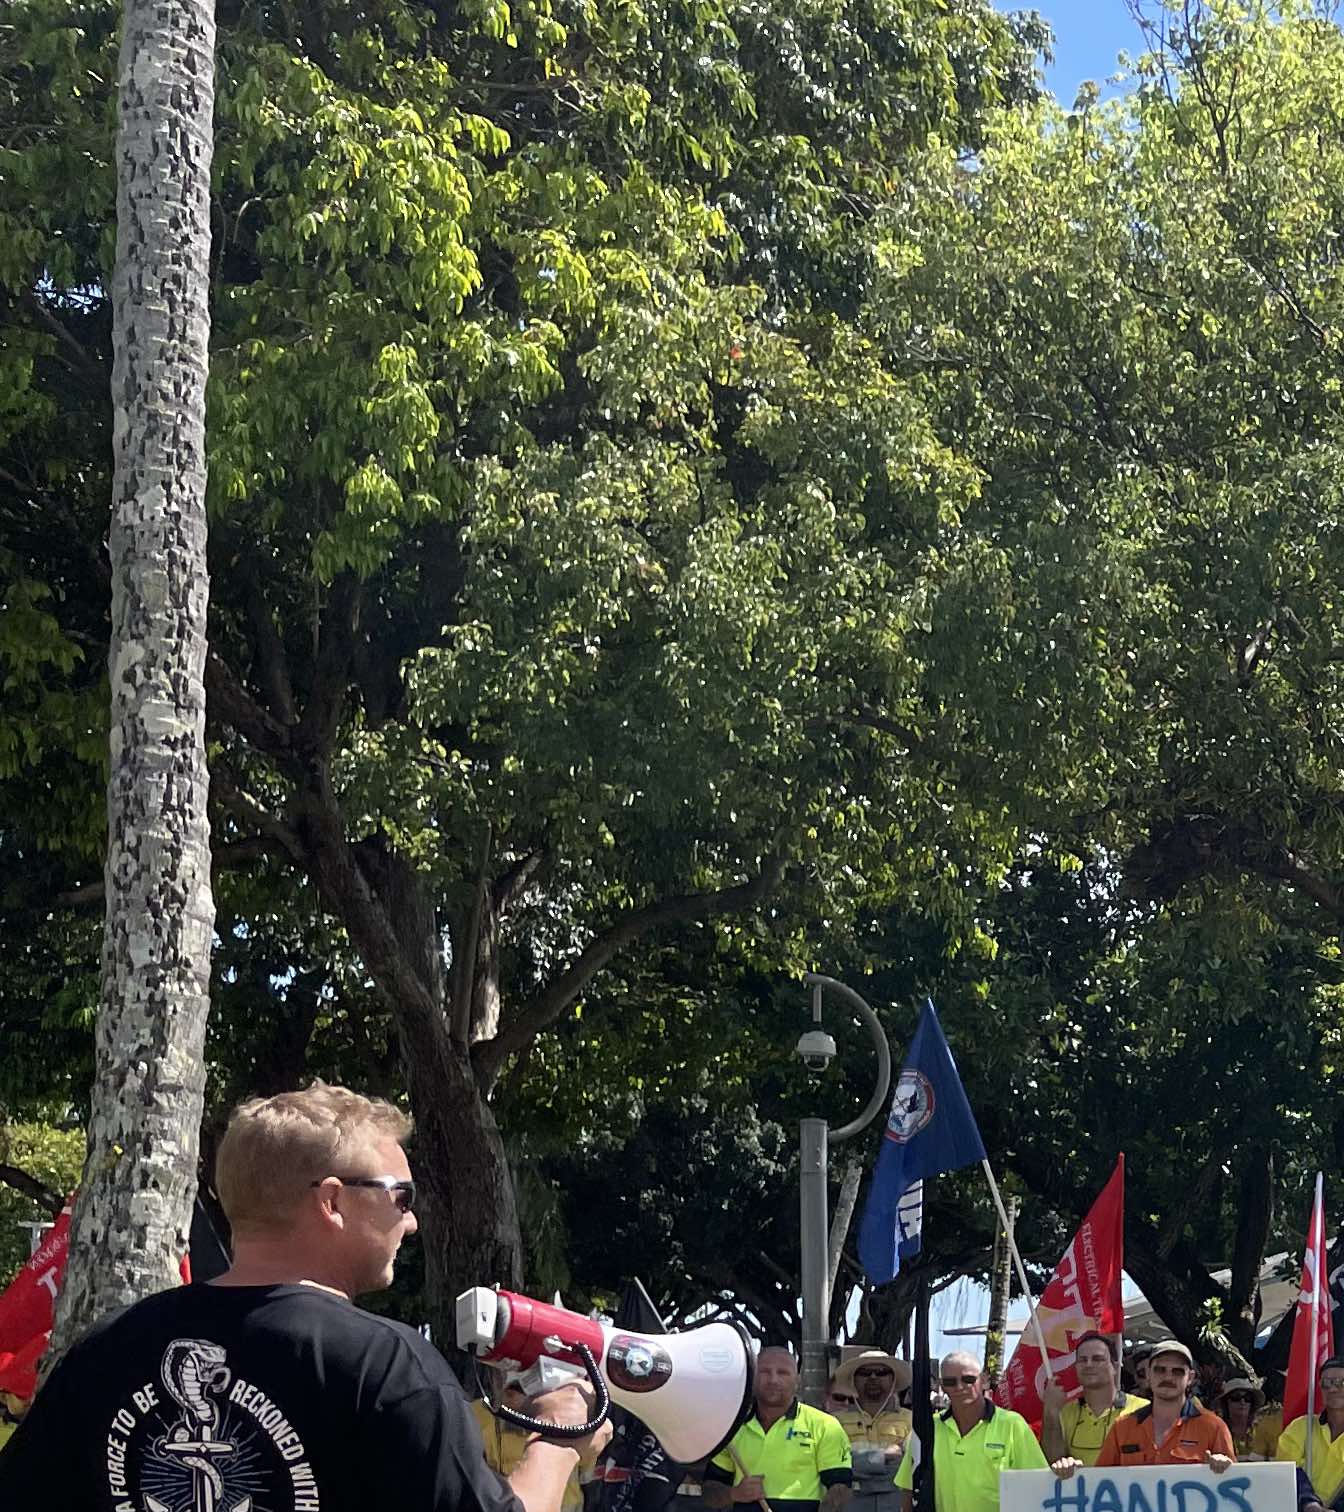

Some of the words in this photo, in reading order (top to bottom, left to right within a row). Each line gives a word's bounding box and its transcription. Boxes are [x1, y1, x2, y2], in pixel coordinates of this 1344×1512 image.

[111, 1408, 136, 1437] TO
[132, 1382, 160, 1415] BE
[228, 1378, 306, 1462] RECKONED
[106, 1434, 128, 1498] FORCE
[287, 1461, 321, 1512] WITH
